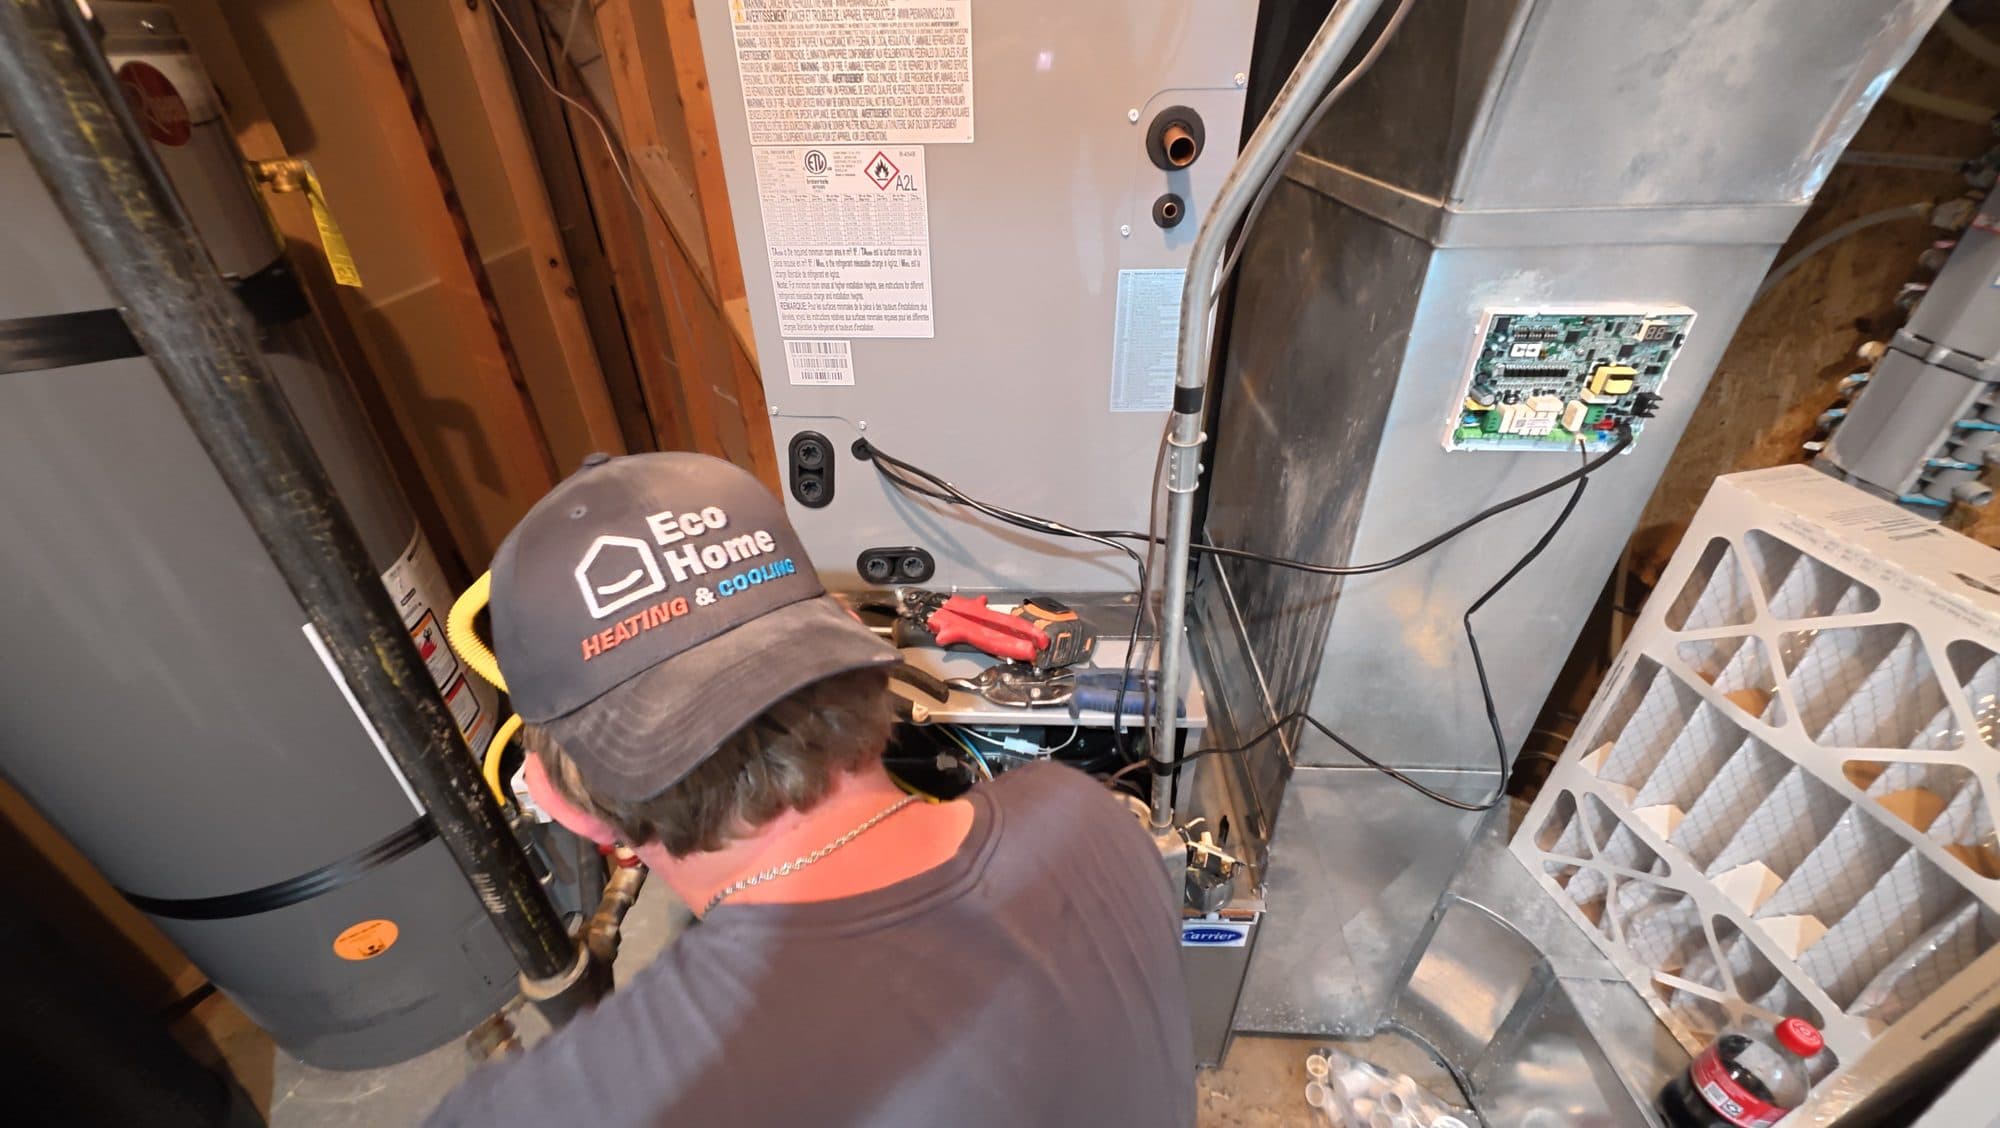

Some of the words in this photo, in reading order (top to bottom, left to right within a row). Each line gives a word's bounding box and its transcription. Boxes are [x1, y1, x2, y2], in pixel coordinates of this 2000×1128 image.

[896, 174, 918, 191] A2L
[646, 506, 728, 546] Eco
[663, 530, 776, 583] Home
[581, 596, 689, 662] HEATING
[695, 587, 717, 607] &
[718, 558, 796, 597] COOLING
[1183, 931, 1236, 940] Carrier
